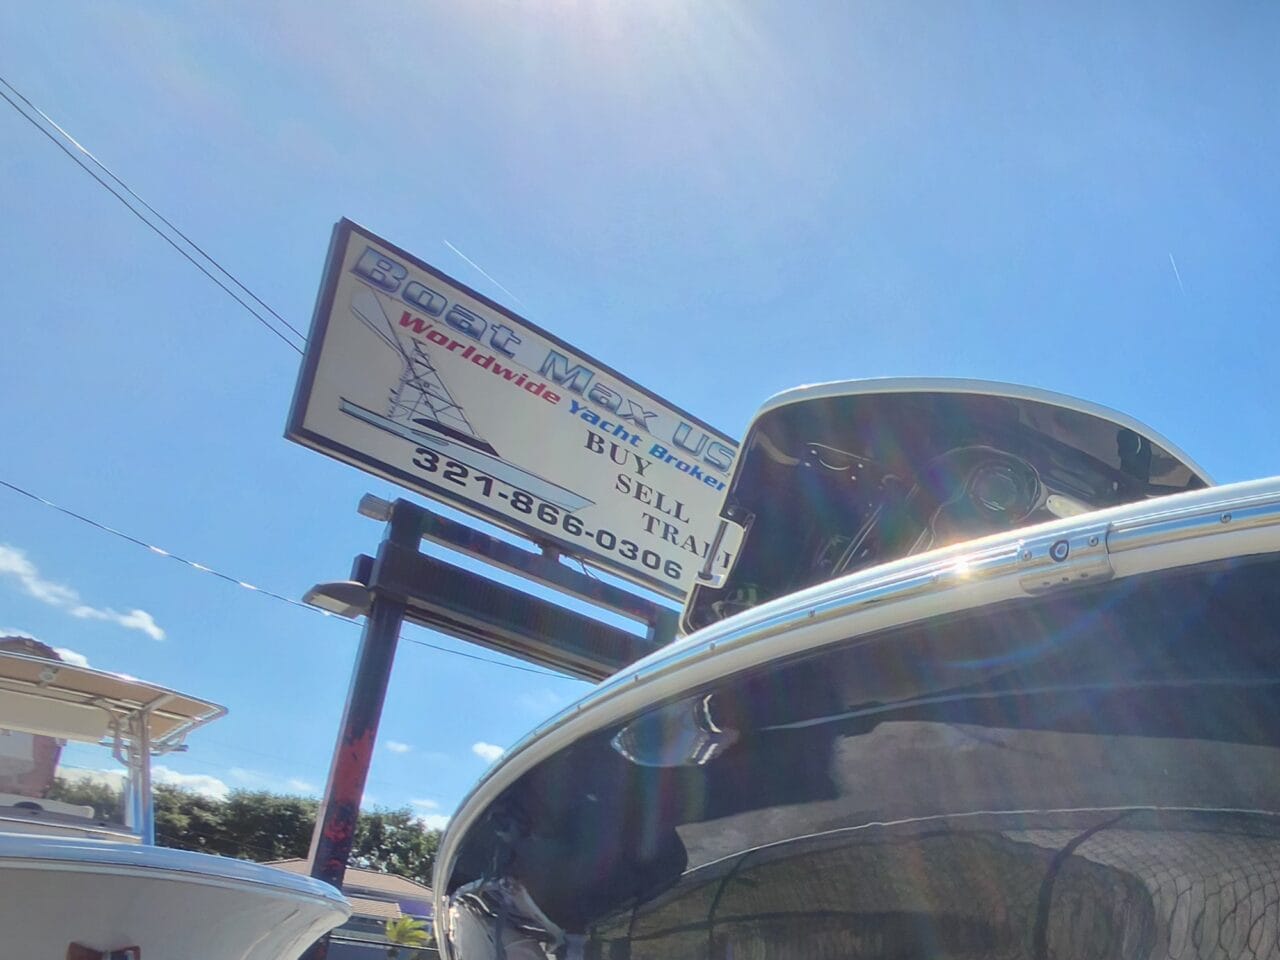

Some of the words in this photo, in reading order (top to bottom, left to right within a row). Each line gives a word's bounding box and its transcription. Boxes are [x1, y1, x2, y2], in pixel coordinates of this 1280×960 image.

[351, 246, 522, 359] Boat
[536, 348, 659, 432] Max
[399, 310, 561, 405] Worldwide
[569, 400, 643, 447] Yacht
[412, 447, 683, 580] 321-866-0306
[584, 429, 652, 477] BUY
[615, 473, 690, 524] SELL
